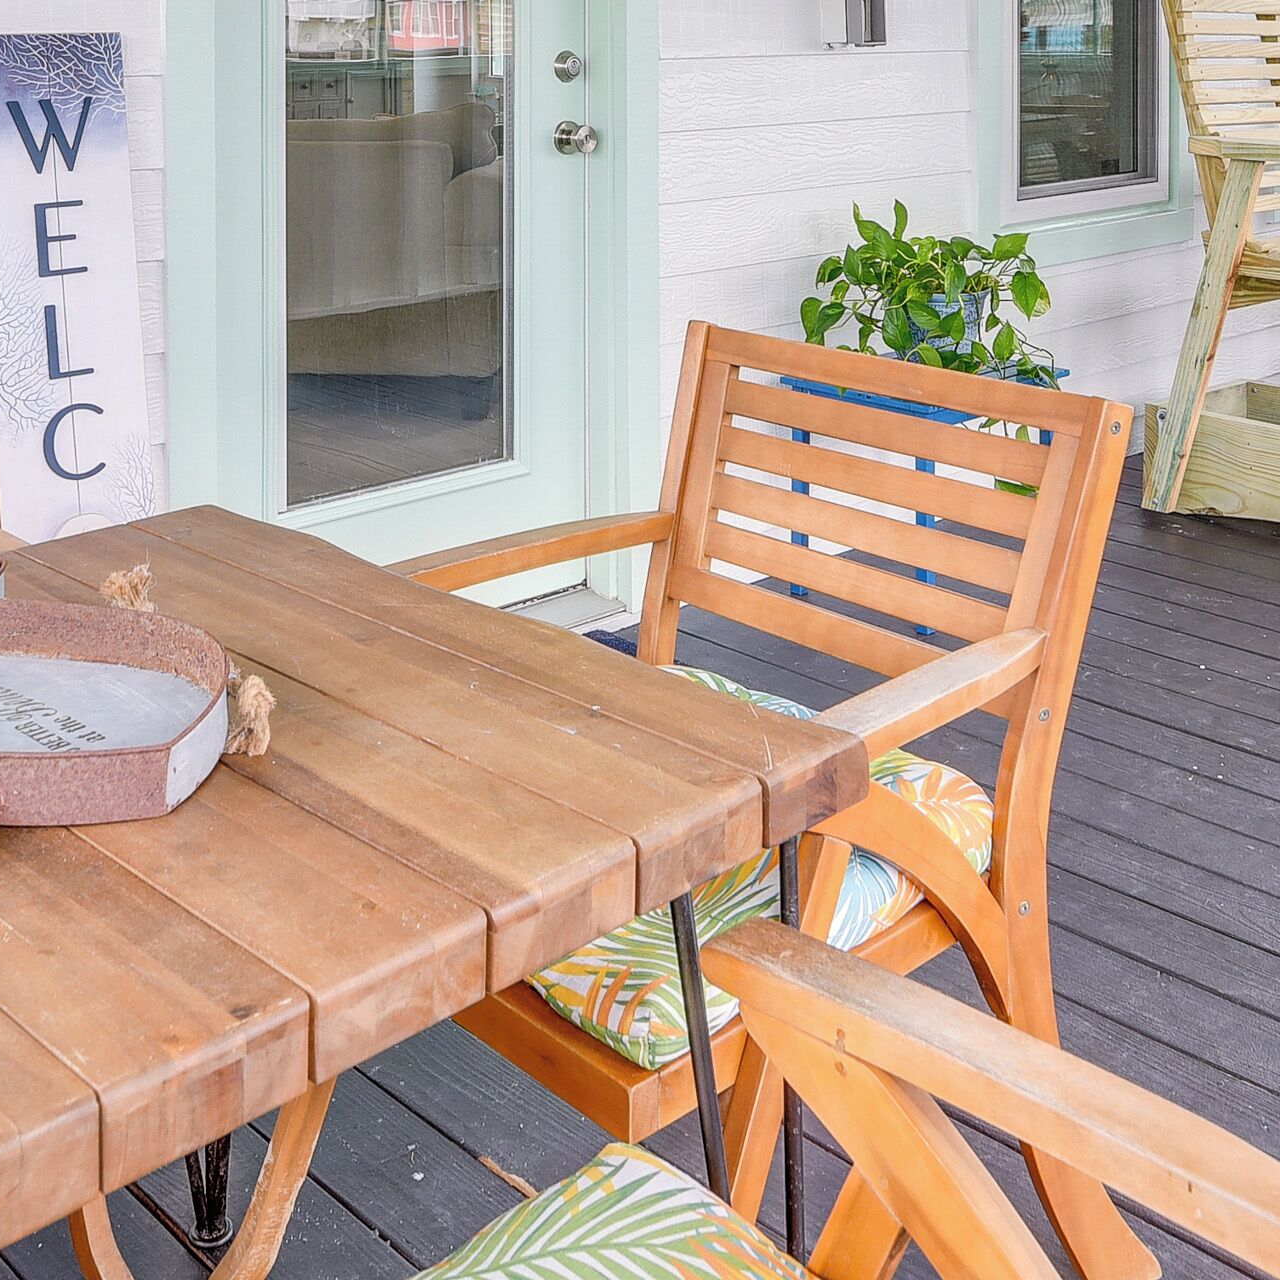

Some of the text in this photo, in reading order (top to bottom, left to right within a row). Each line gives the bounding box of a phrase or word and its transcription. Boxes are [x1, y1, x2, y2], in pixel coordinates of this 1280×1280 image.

[54, 715, 86, 734] the
[14, 721, 71, 751] BETTER
[77, 730, 107, 744] at
